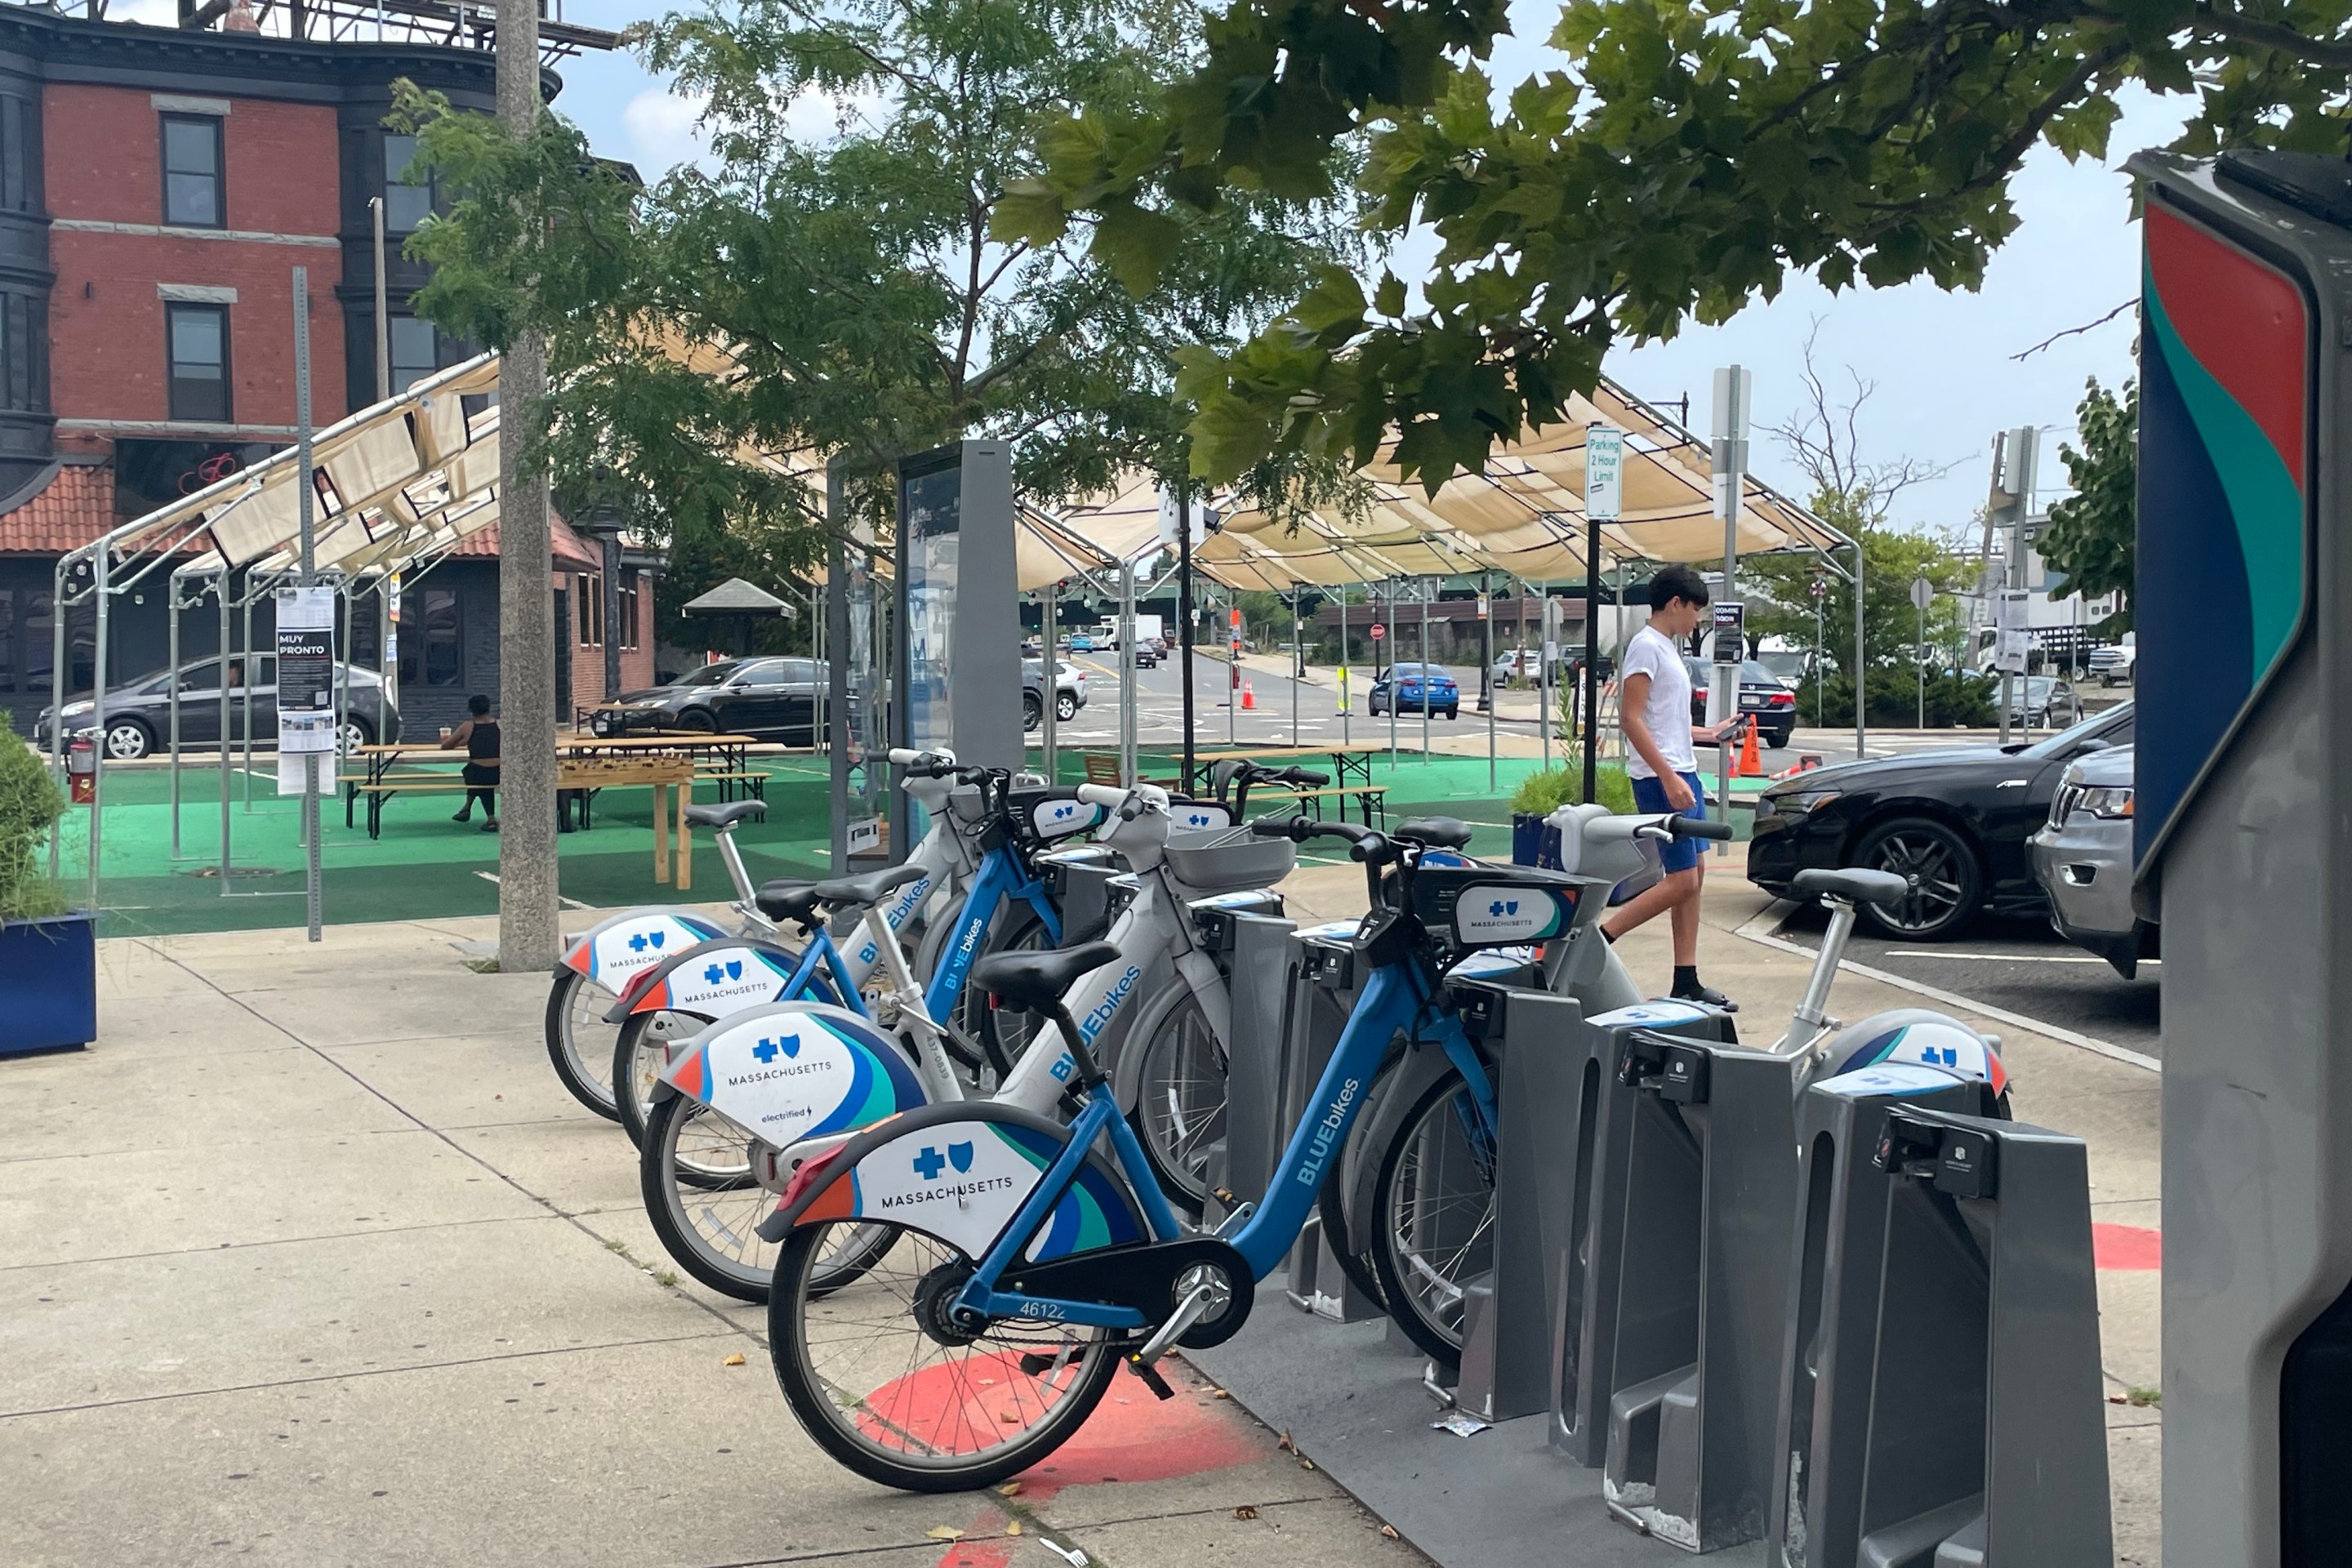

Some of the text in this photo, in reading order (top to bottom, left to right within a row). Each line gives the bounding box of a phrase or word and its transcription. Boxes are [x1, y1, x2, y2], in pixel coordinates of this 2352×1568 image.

[1590, 439, 1619, 453] Parking
[1592, 455, 1616, 466] 2 Hour
[1594, 470, 1614, 482] Limit
[279, 635, 304, 644] MUY
[279, 646, 324, 654] PRONTO
[1471, 919, 1532, 927] MASSACHUSETTS
[684, 982, 768, 1003] MASSACHUSETTS
[728, 1061, 831, 1086] MASSACHUSETTS
[761, 1108, 805, 1123] electrified
[1297, 1078, 1359, 1186] BLUEbikes
[881, 1177, 1013, 1209] MASSACHUSETTS
